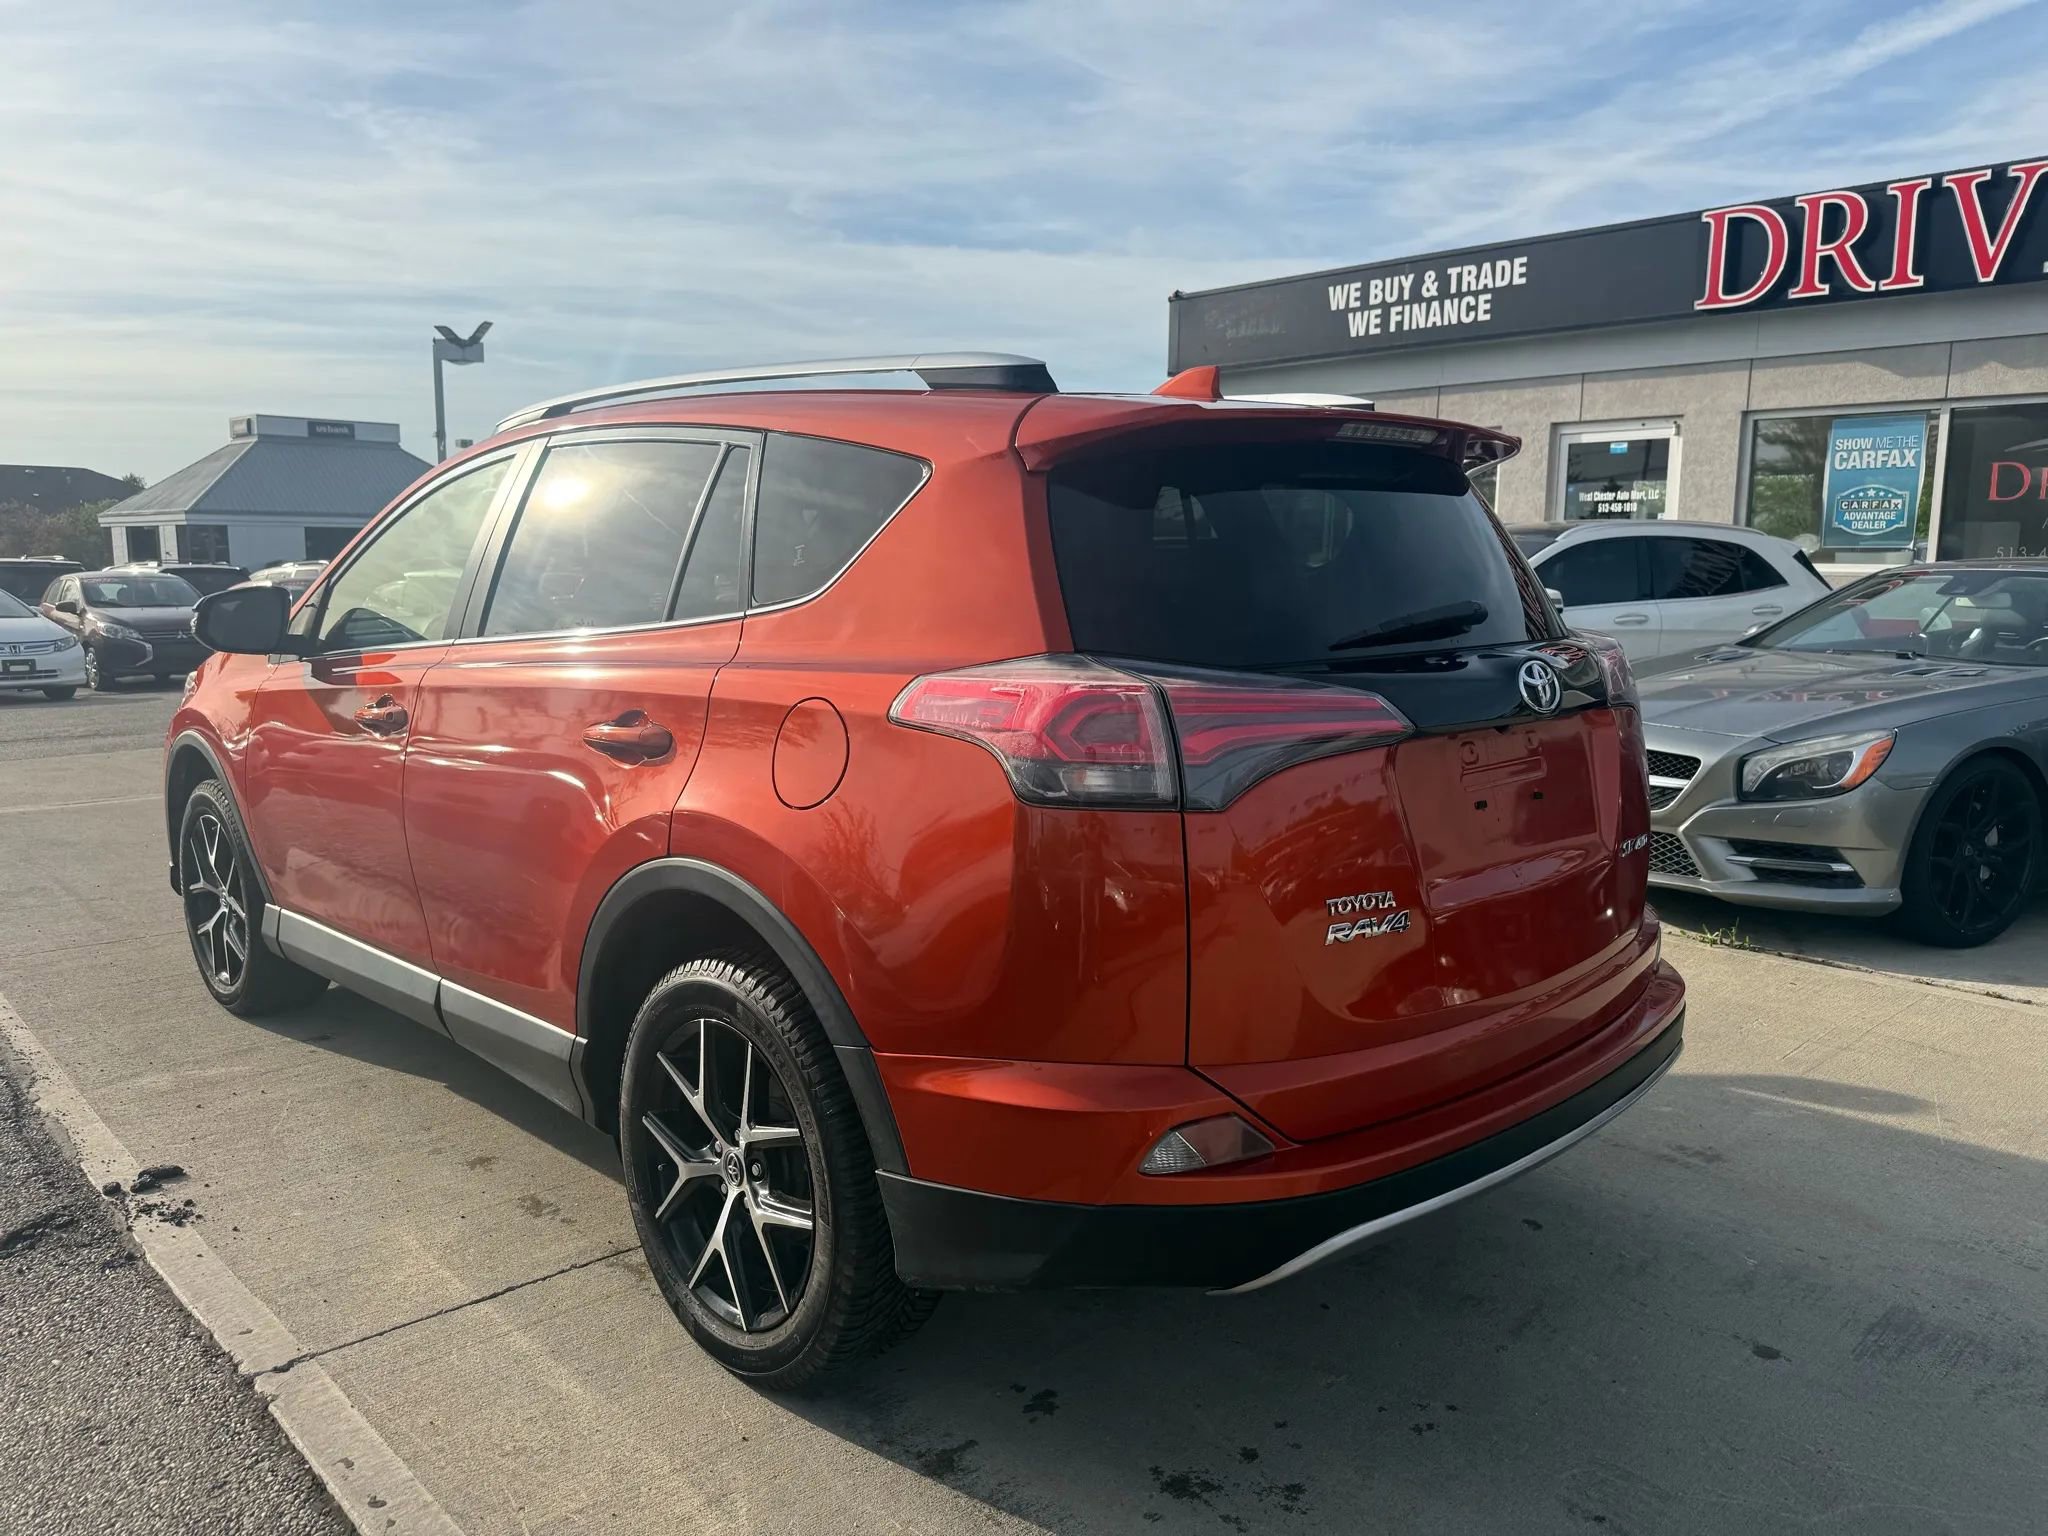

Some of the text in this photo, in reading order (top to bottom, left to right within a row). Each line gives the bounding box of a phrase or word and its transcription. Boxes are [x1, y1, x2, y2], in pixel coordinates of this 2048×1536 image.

[1694, 160, 2048, 310] DRIV
[1328, 256, 1528, 311] WE BUY & TRADE
[1348, 293, 1492, 338] WE FINANCE
[1835, 435, 1919, 451] SHOW ME THE
[1834, 448, 1920, 470] CARFAX
[1616, 490, 1630, 501] Auto
[1648, 488, 1660, 500] LLC
[1839, 499, 1902, 511] CARFAX
[1843, 511, 1897, 521] ADVANTAGE
[1851, 520, 1887, 530] DEALER
[1325, 891, 1397, 917] TOYOTA
[1324, 909, 1411, 946] RAV4
